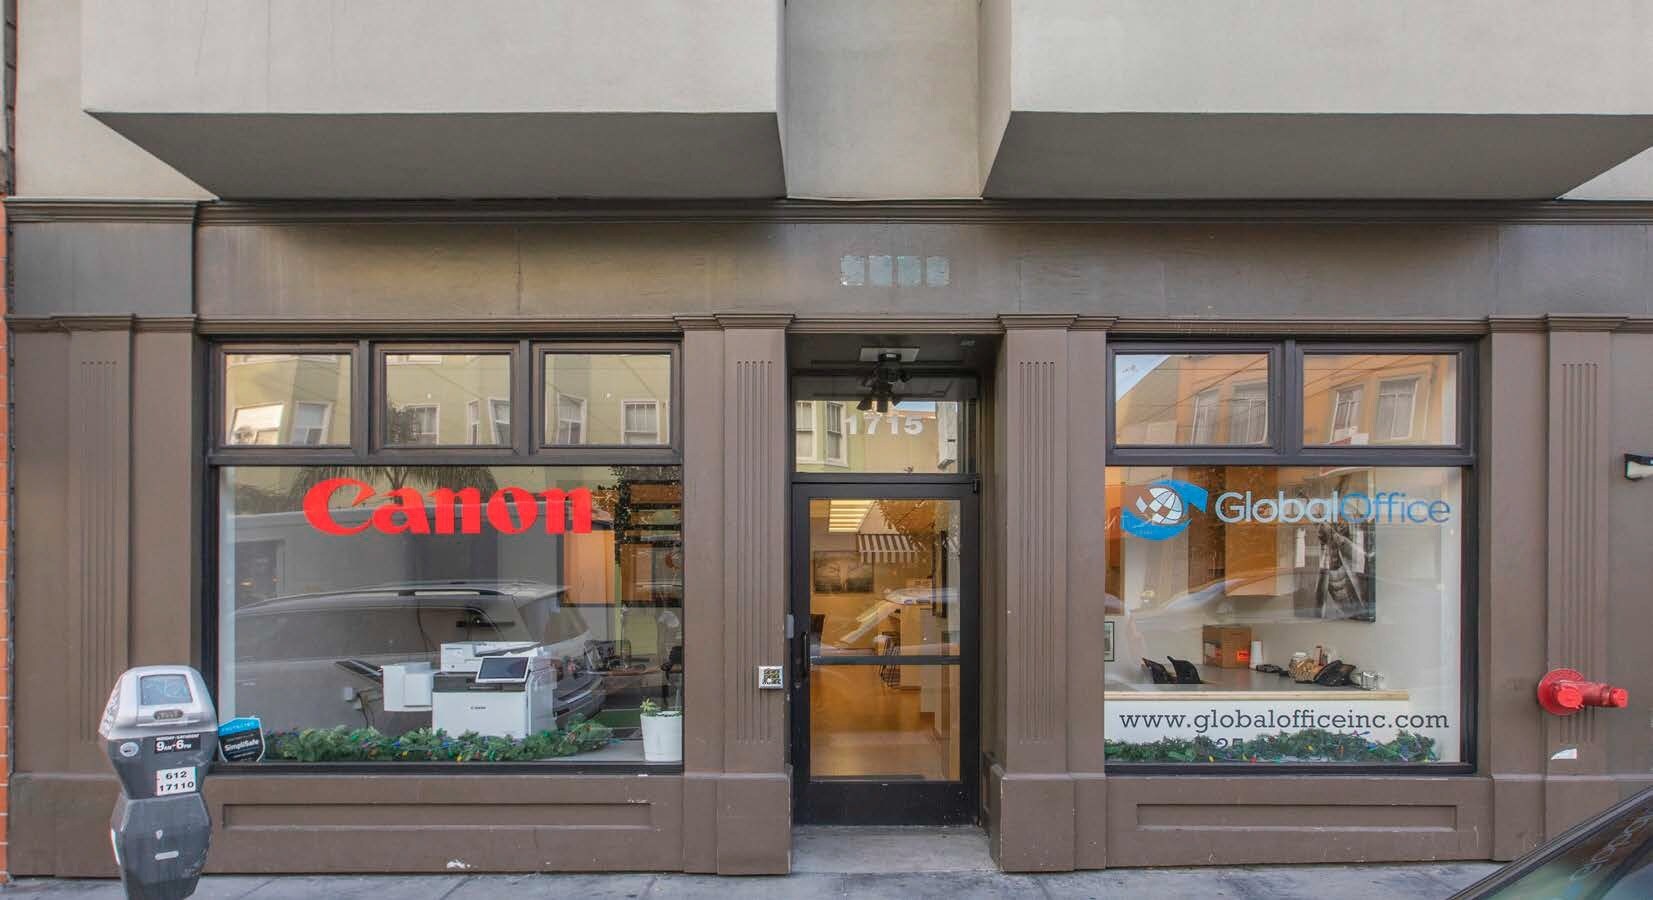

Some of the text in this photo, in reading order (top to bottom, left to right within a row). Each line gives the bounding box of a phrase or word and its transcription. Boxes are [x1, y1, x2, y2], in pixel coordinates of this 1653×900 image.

[845, 415, 923, 435] 1715
[303, 477, 592, 535] Canon
[1215, 490, 1451, 524] GlobalOffice
[1119, 709, 1449, 734] www.globalofficeinc.com
[165, 770, 187, 780] 612
[160, 781, 194, 792] 17110
